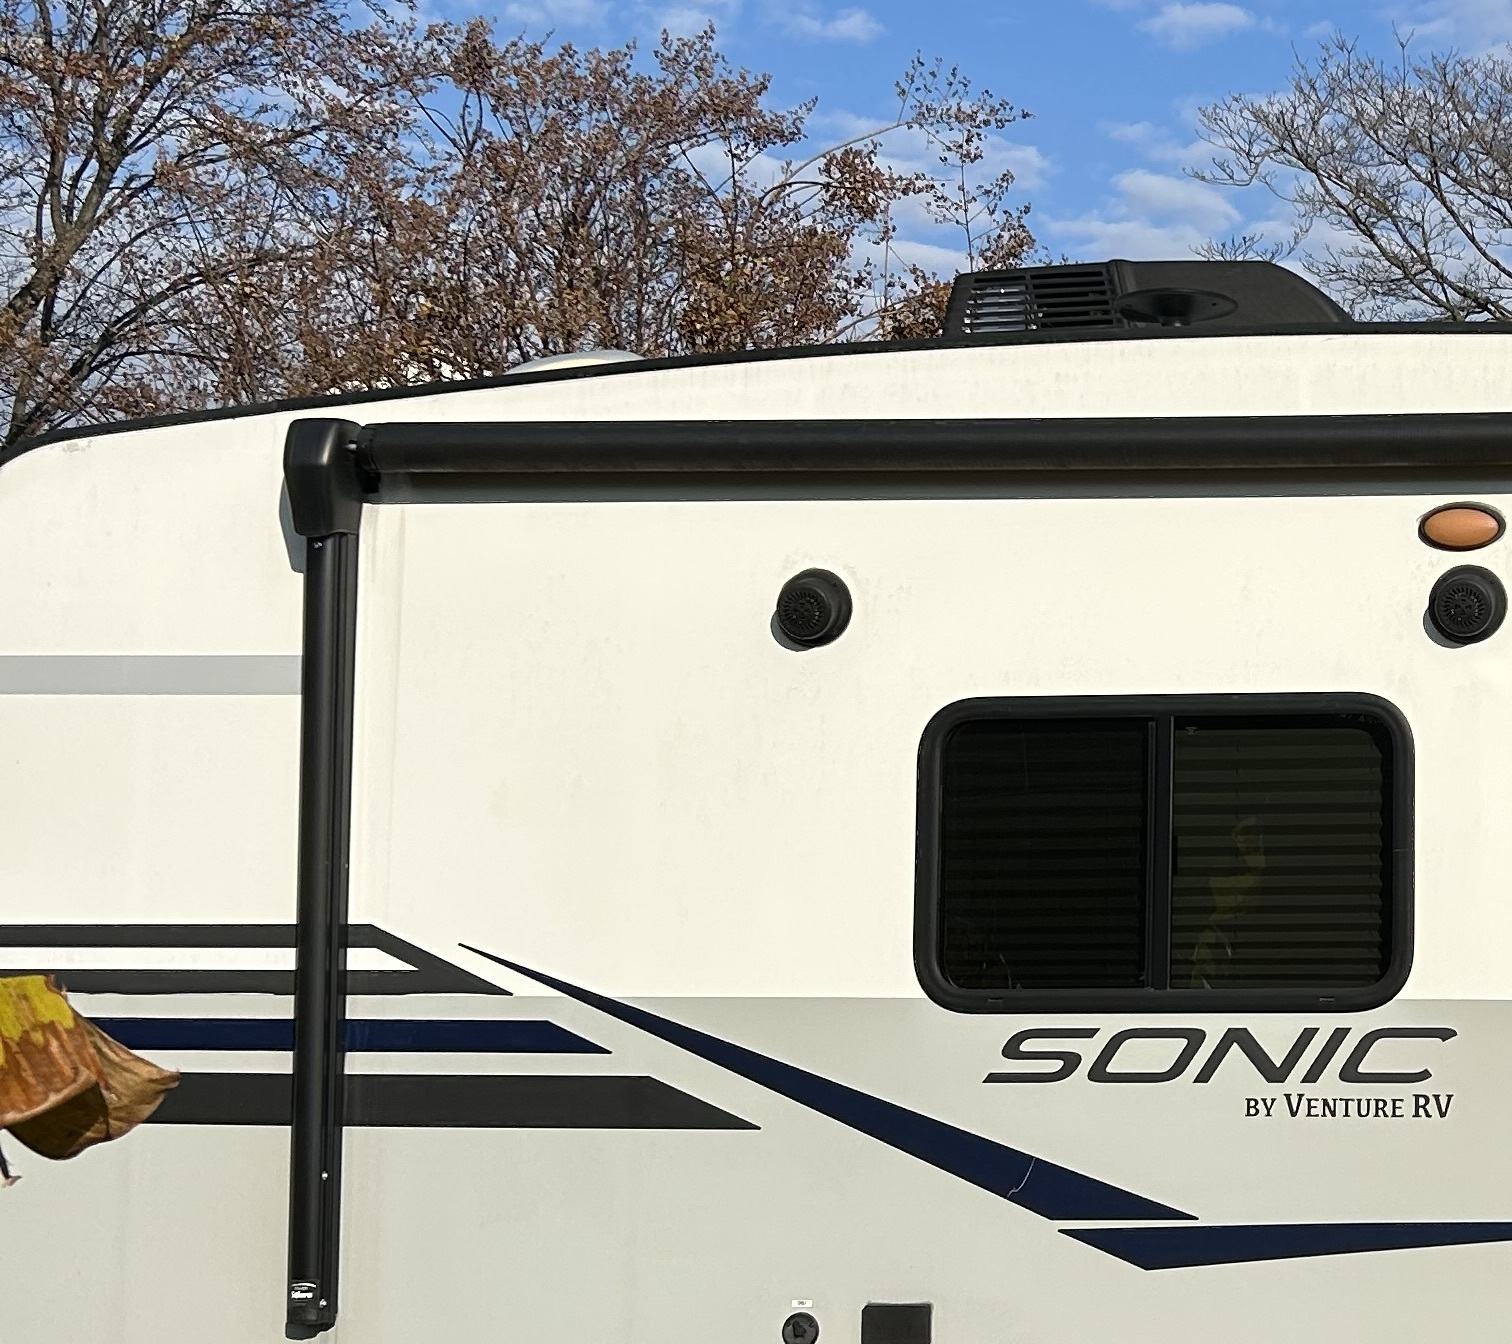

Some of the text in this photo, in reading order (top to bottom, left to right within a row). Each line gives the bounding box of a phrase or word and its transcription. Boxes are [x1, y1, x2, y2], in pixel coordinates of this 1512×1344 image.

[982, 1027, 1458, 1083] SONIC
[1245, 1093, 1455, 1118] BY VENTURE RV
